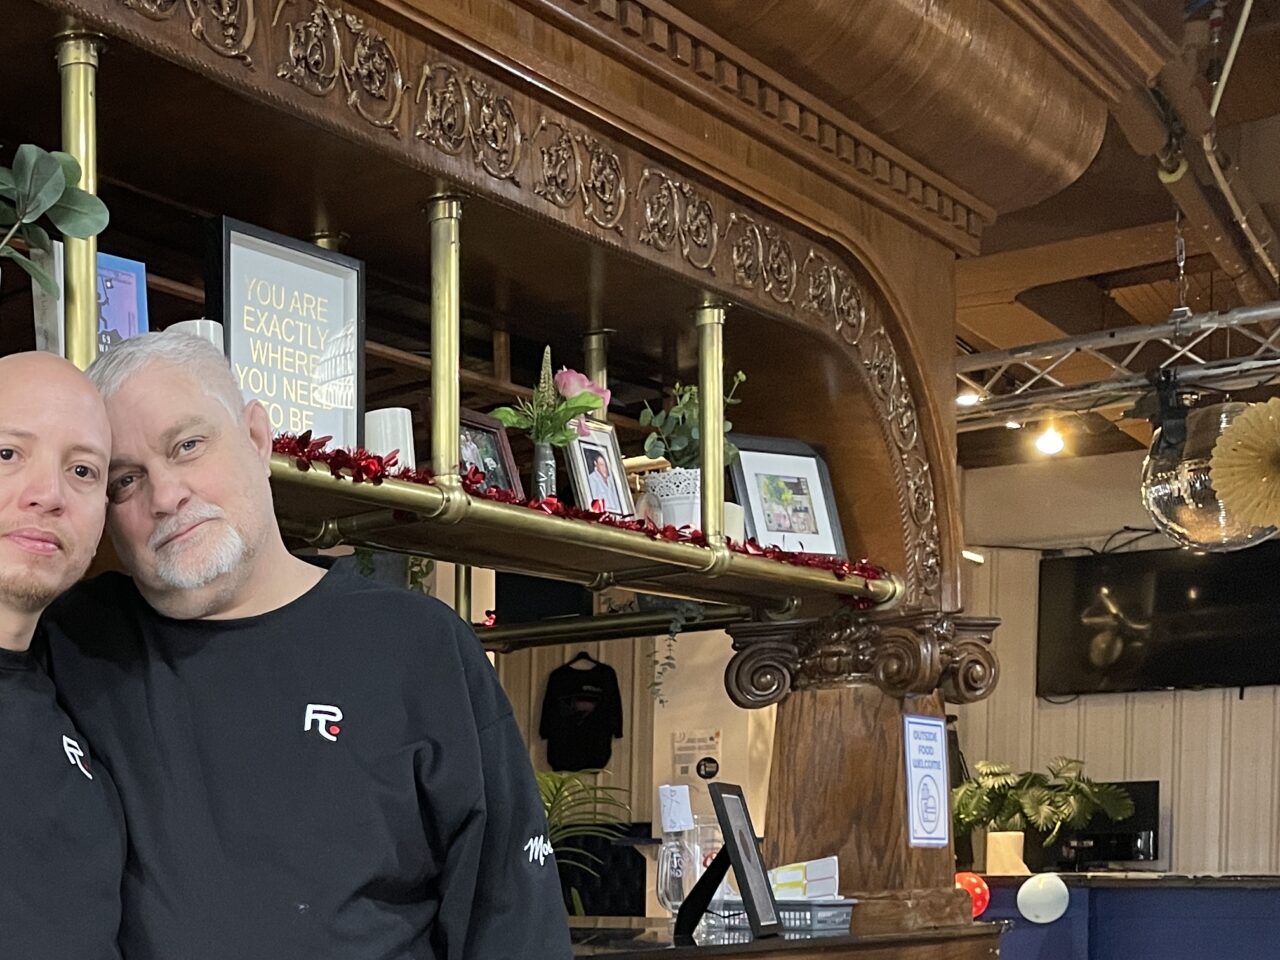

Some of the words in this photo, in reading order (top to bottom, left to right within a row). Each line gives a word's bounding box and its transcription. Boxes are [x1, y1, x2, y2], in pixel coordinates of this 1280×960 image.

[245, 275, 285, 310] YOU
[289, 290, 329, 322] ARE
[243, 305, 329, 350] EXACTLY
[249, 337, 321, 378] WHERE
[235, 363, 277, 397] YOU
[283, 376, 334, 410] NEED
[289, 407, 314, 432] BE
[913, 730, 938, 742] OUTSIDE
[918, 744, 935, 756] FOOD
[912, 758, 942, 770] WELCOME
